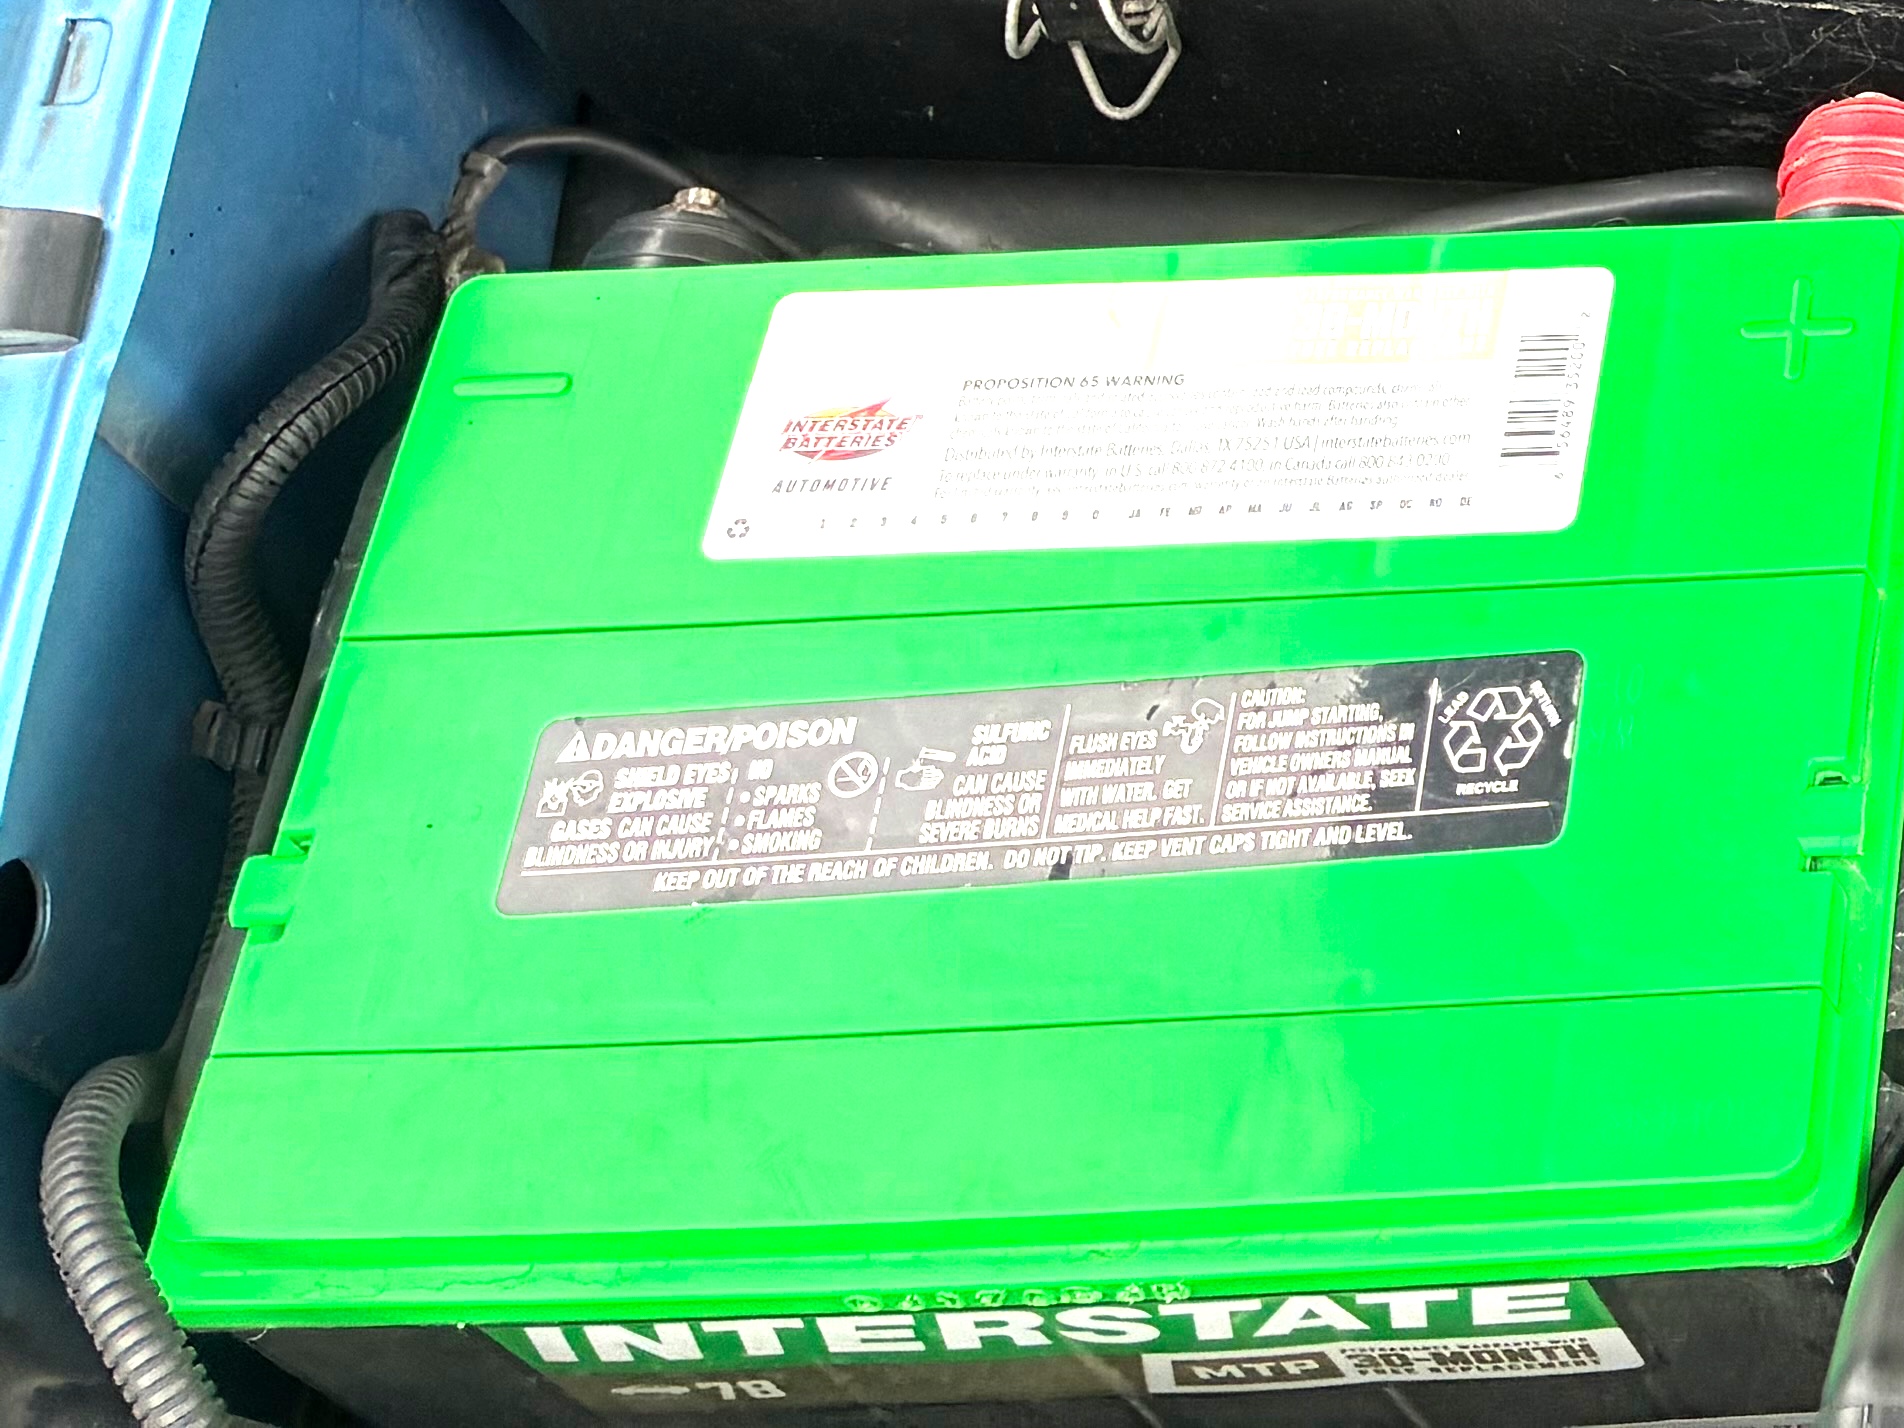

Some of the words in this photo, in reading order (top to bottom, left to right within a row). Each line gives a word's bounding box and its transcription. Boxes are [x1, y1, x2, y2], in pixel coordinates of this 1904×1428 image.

[962, 376, 1076, 391] PROPOSITION
[1079, 375, 1100, 388] 65
[1105, 373, 1185, 387] WARNING
[781, 416, 913, 433] INTERSTATE
[779, 432, 898, 451] BATTERIES
[1235, 436, 1279, 451] 75251
[1283, 435, 1311, 450] USA
[772, 476, 892, 494] AUTOMOTIVE
[1241, 687, 1306, 708] CAUTION:
[1437, 690, 1470, 724] LEAD
[1237, 711, 1267, 730] FOR
[1267, 708, 1310, 728] JUMP
[1310, 703, 1383, 725] STARTING,
[591, 717, 858, 760] DANGER/POISON
[972, 720, 1051, 745] SULFURIC
[1068, 732, 1118, 755] FLUSH
[1119, 729, 1158, 752] EYES
[1233, 731, 1293, 753] FOLLOW
[1294, 723, 1397, 749] INSTRUCTIONS
[1399, 722, 1415, 742] IN
[748, 758, 774, 780] NO
[965, 744, 1007, 767] ACID
[1063, 754, 1166, 782] IMMEDIATELY
[1230, 753, 1288, 776] VEHICLE
[1289, 749, 1351, 772] OWNERS
[1353, 745, 1412, 767] MANUAL
[614, 764, 681, 789] SHIELD
[684, 761, 732, 786] EYES
[953, 773, 989, 796] CAN
[990, 769, 1047, 793] CAUSE
[1225, 779, 1248, 799] OR
[1249, 777, 1265, 797] IF
[1265, 776, 1296, 797] NOT
[1296, 770, 1377, 795] AVAILABLE,
[1379, 768, 1416, 788] SEEK
[1455, 779, 1519, 796] RECYCLE
[607, 787, 708, 814] EXPLOSIVE
[752, 781, 822, 806] SPARKS
[924, 794, 1016, 821] BLINDNESS
[1017, 792, 1043, 815] OR
[1059, 785, 1100, 808] WITH
[1101, 781, 1157, 805] WATER.
[1162, 778, 1193, 800] GET
[748, 805, 817, 830] FLAMES
[1053, 810, 1119, 835] MEDICAL
[1122, 806, 1162, 830] HELP
[1162, 804, 1205, 826] FAST.
[1221, 799, 1282, 823] SERVICE
[1282, 793, 1373, 818] ASSISTANCE.
[551, 817, 612, 842] GASES
[617, 815, 655, 839] CAN
[655, 812, 713, 837] CAUSE
[918, 818, 982, 844] SEVERE
[983, 815, 1040, 839] BURNS
[523, 841, 621, 868] BLINDNESS
[621, 840, 650, 862] OR
[741, 829, 823, 855] SMOKING
[652, 870, 701, 892] KEEP
[701, 867, 739, 890] OUT
[742, 865, 770, 887] OF
[771, 863, 806, 885] THE
[807, 859, 867, 882] REACH
[872, 857, 899, 878] OF
[900, 850, 995, 875] CHILDREN.
[1004, 848, 1032, 870] DO
[1034, 846, 1070, 868] NOT
[1072, 843, 1106, 865] TIP.
[1111, 840, 1157, 862] KEEP
[1159, 836, 1206, 859] VENT
[1208, 832, 1255, 855] CAPS
[1258, 828, 1311, 851] TIGHT
[1312, 825, 1353, 846] AND
[1354, 820, 1414, 843] LEVEL.
[523, 1281, 1571, 1363] INTERSTATE
[1191, 1358, 1322, 1381] MTP
[1346, 1343, 1600, 1369] 30-MONTH
[695, 1378, 787, 1402] 78
